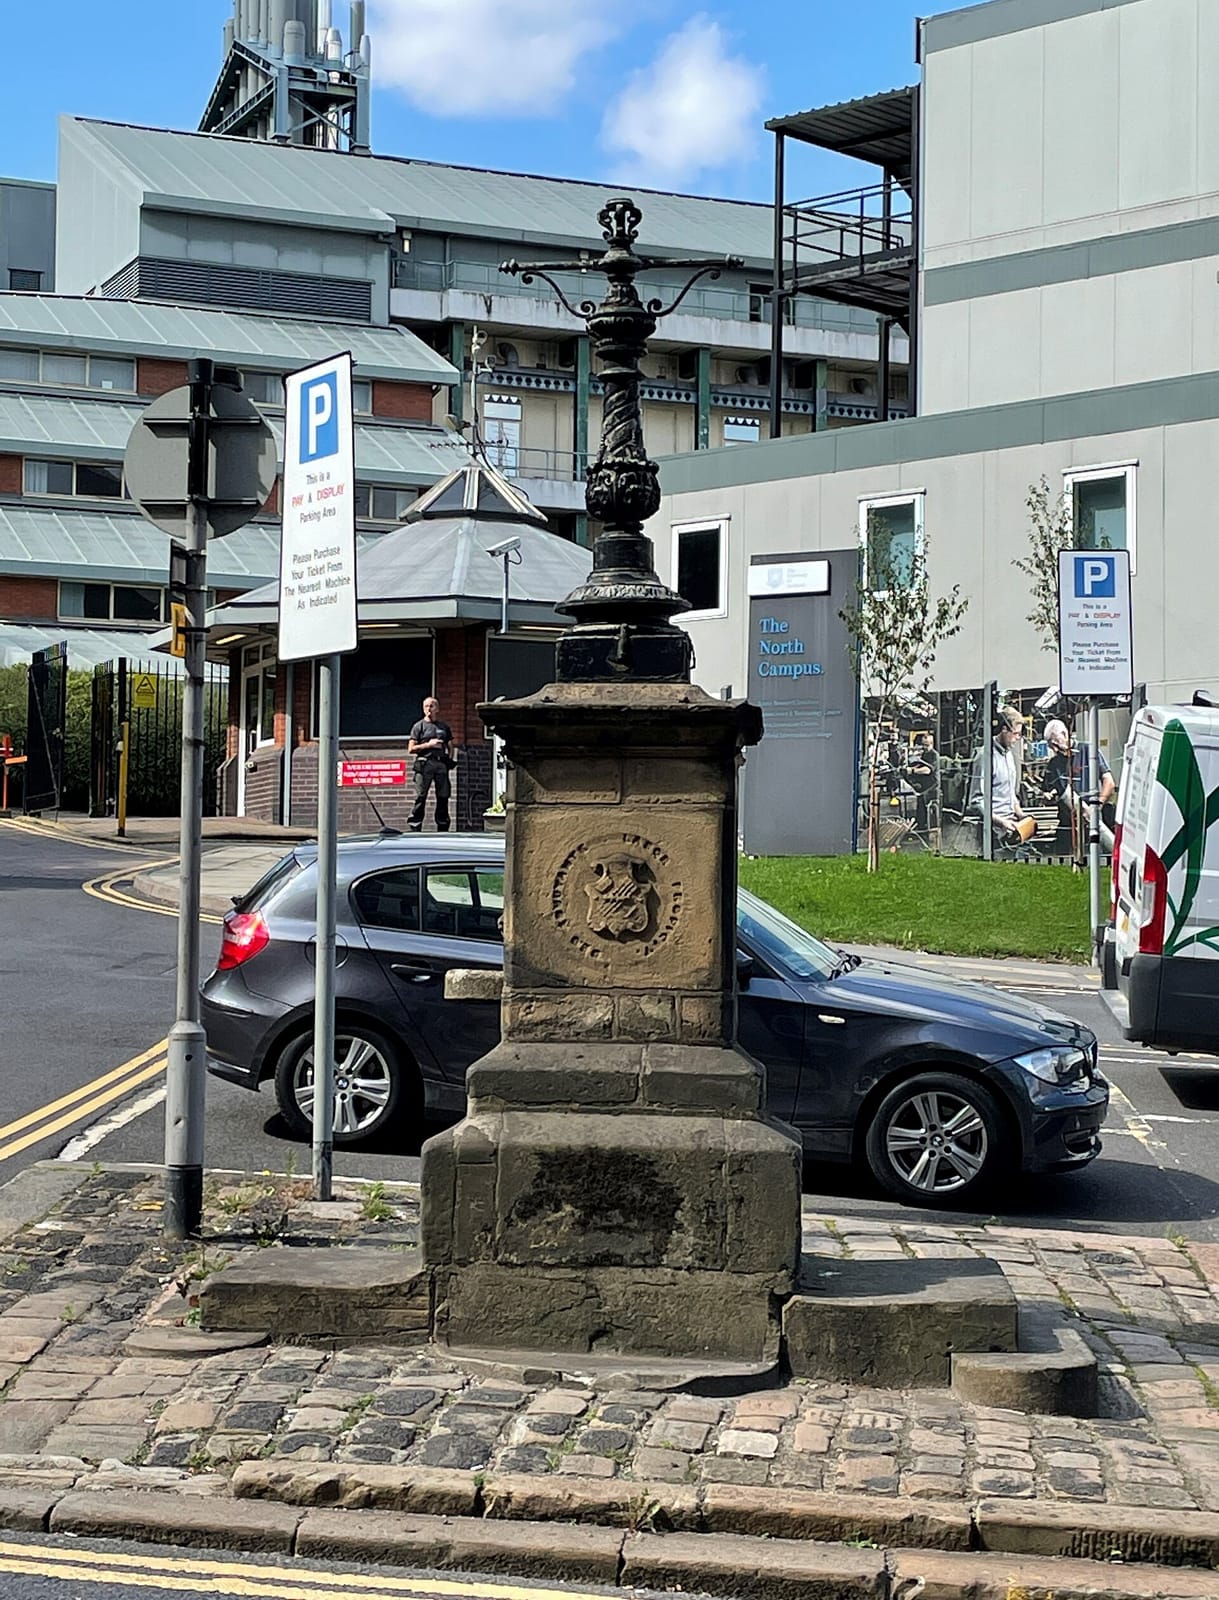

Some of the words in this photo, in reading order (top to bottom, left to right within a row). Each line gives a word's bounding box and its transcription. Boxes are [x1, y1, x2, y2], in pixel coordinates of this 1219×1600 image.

[308, 382, 333, 456] P
[306, 473, 318, 485] This
[291, 494, 304, 508] PAY
[316, 482, 345, 501] DISPLAY
[300, 510, 321, 524] Parking
[322, 506, 336, 519] Area
[292, 553, 311, 565] Please
[313, 546, 341, 560] Purchase
[290, 569, 304, 580] Your
[307, 564, 326, 577] Ticket
[327, 561, 343, 573] From
[1083, 560, 1109, 595] P
[284, 586, 295, 597] The
[297, 580, 321, 595] Nearest
[325, 576, 351, 589] Machine
[297, 599, 306, 610] As
[309, 591, 337, 608] Indicated
[759, 617, 789, 633] The
[1077, 621, 1098, 629] Parking
[759, 638, 804, 655] North
